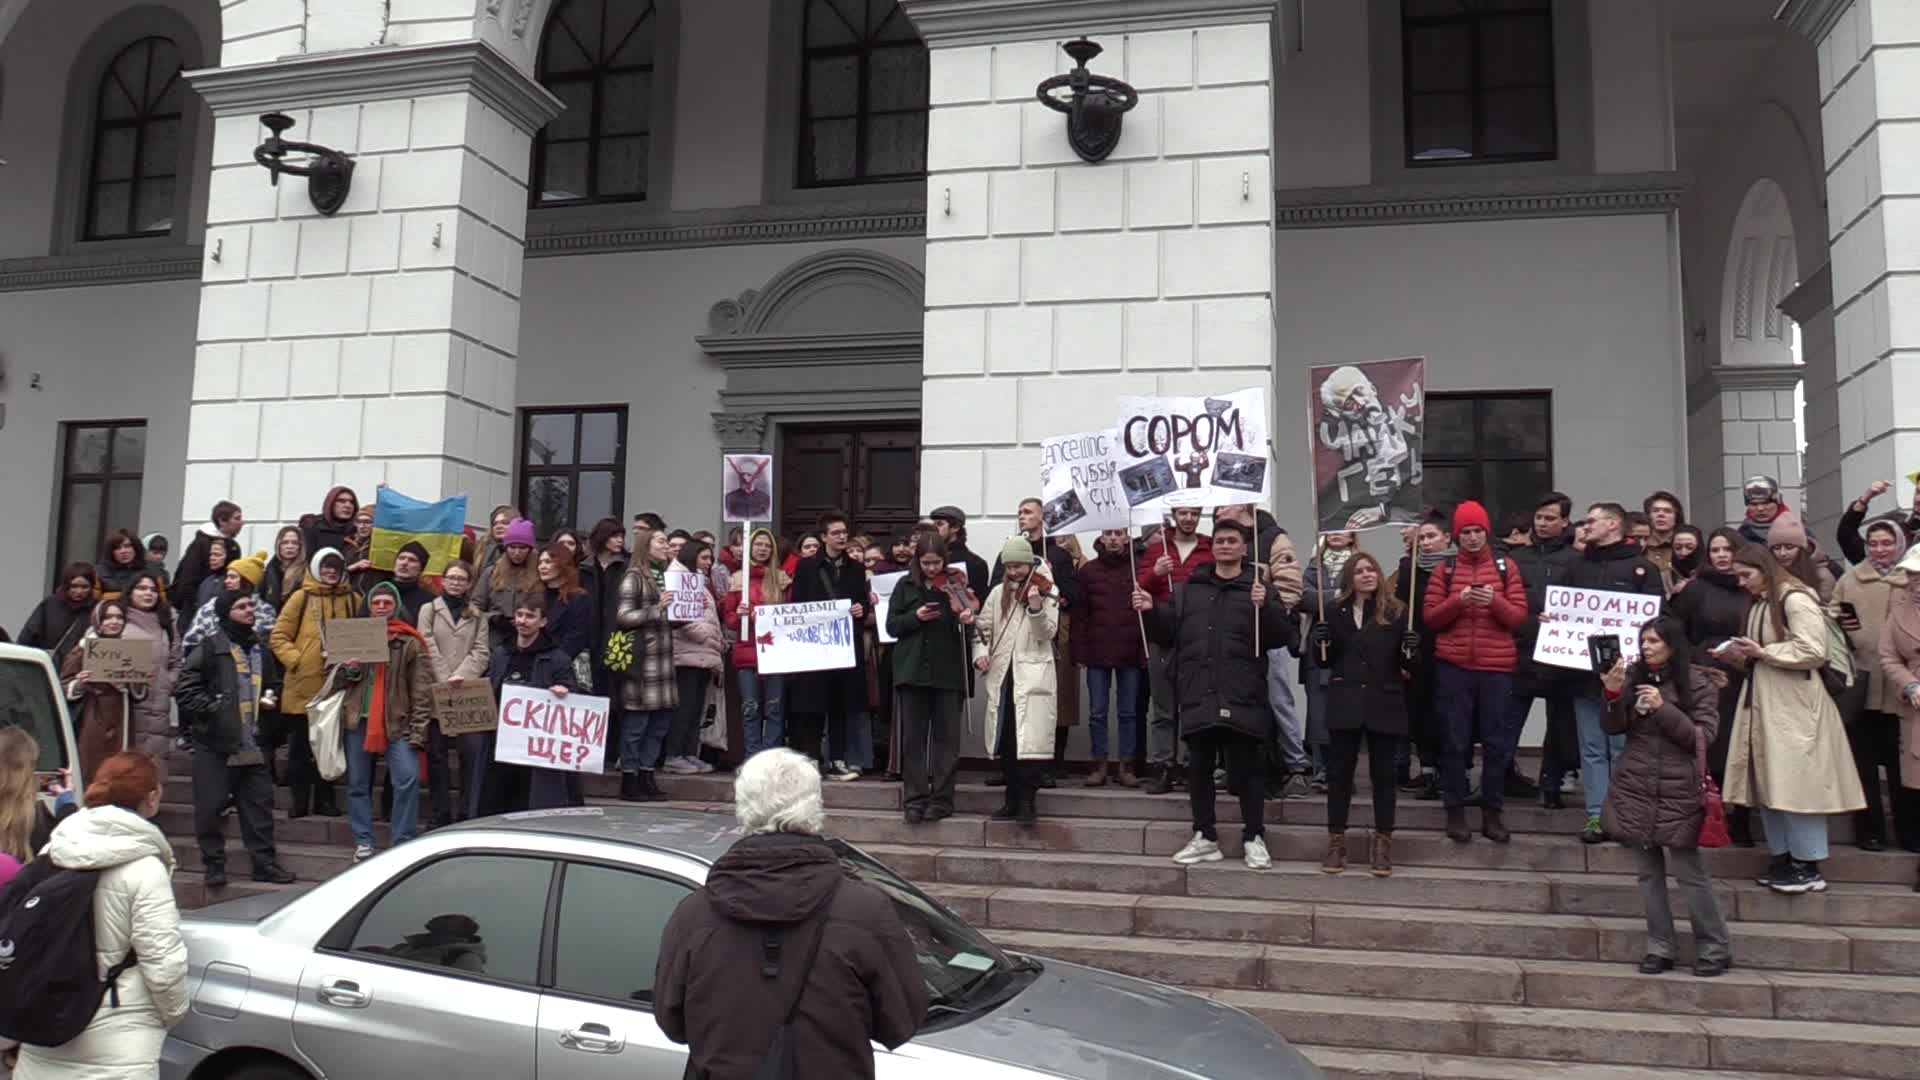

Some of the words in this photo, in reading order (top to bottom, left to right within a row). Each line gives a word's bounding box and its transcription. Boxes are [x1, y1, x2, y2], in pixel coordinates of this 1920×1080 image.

[1124, 408, 1244, 458] СОРОМ
[681, 574, 698, 590] NO
[771, 601, 838, 617] АКАДЕМІЇ
[1549, 590, 1656, 617] СОРОМНО
[783, 615, 805, 626] БЕЗ
[1601, 617, 1623, 628] ВСЕ
[502, 697, 608, 748] СКІЛЬКИ
[527, 736, 591, 770] ЩЕ?
